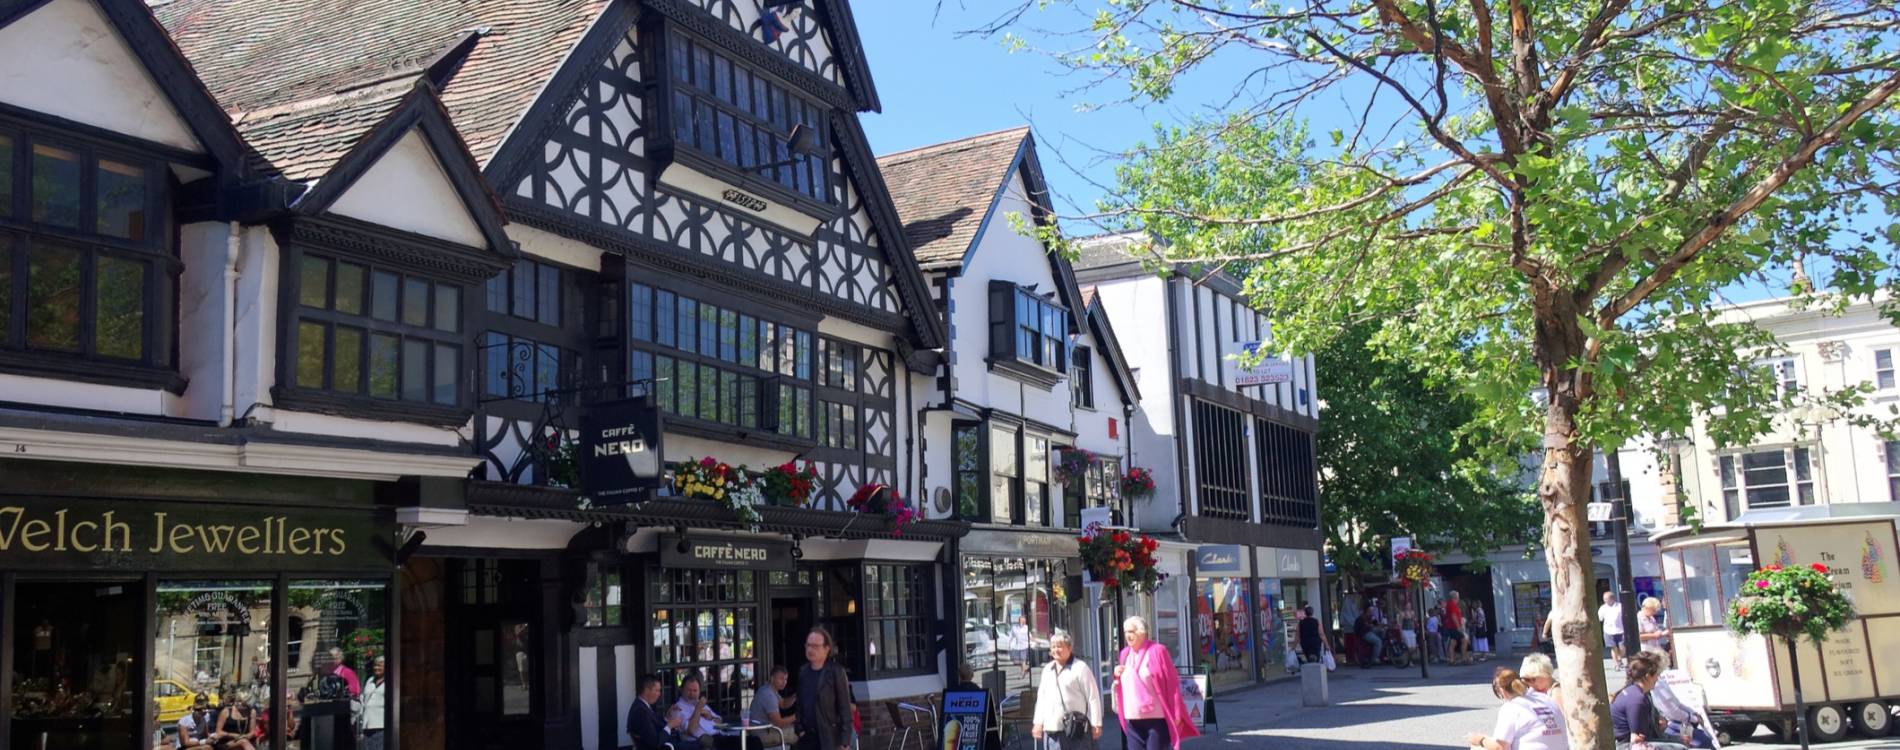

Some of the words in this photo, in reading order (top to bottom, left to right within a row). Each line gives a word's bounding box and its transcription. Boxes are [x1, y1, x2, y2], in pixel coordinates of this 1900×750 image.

[602, 424, 635, 438] CAFFÈ
[16, 444, 26, 452] 14
[594, 439, 644, 457] NERO
[149, 512, 346, 555] Jewellers
[695, 543, 733, 559] CAFFÈ
[734, 548, 767, 560] NERO
[1820, 551, 1835, 560] The
[207, 602, 227, 612] FREE
